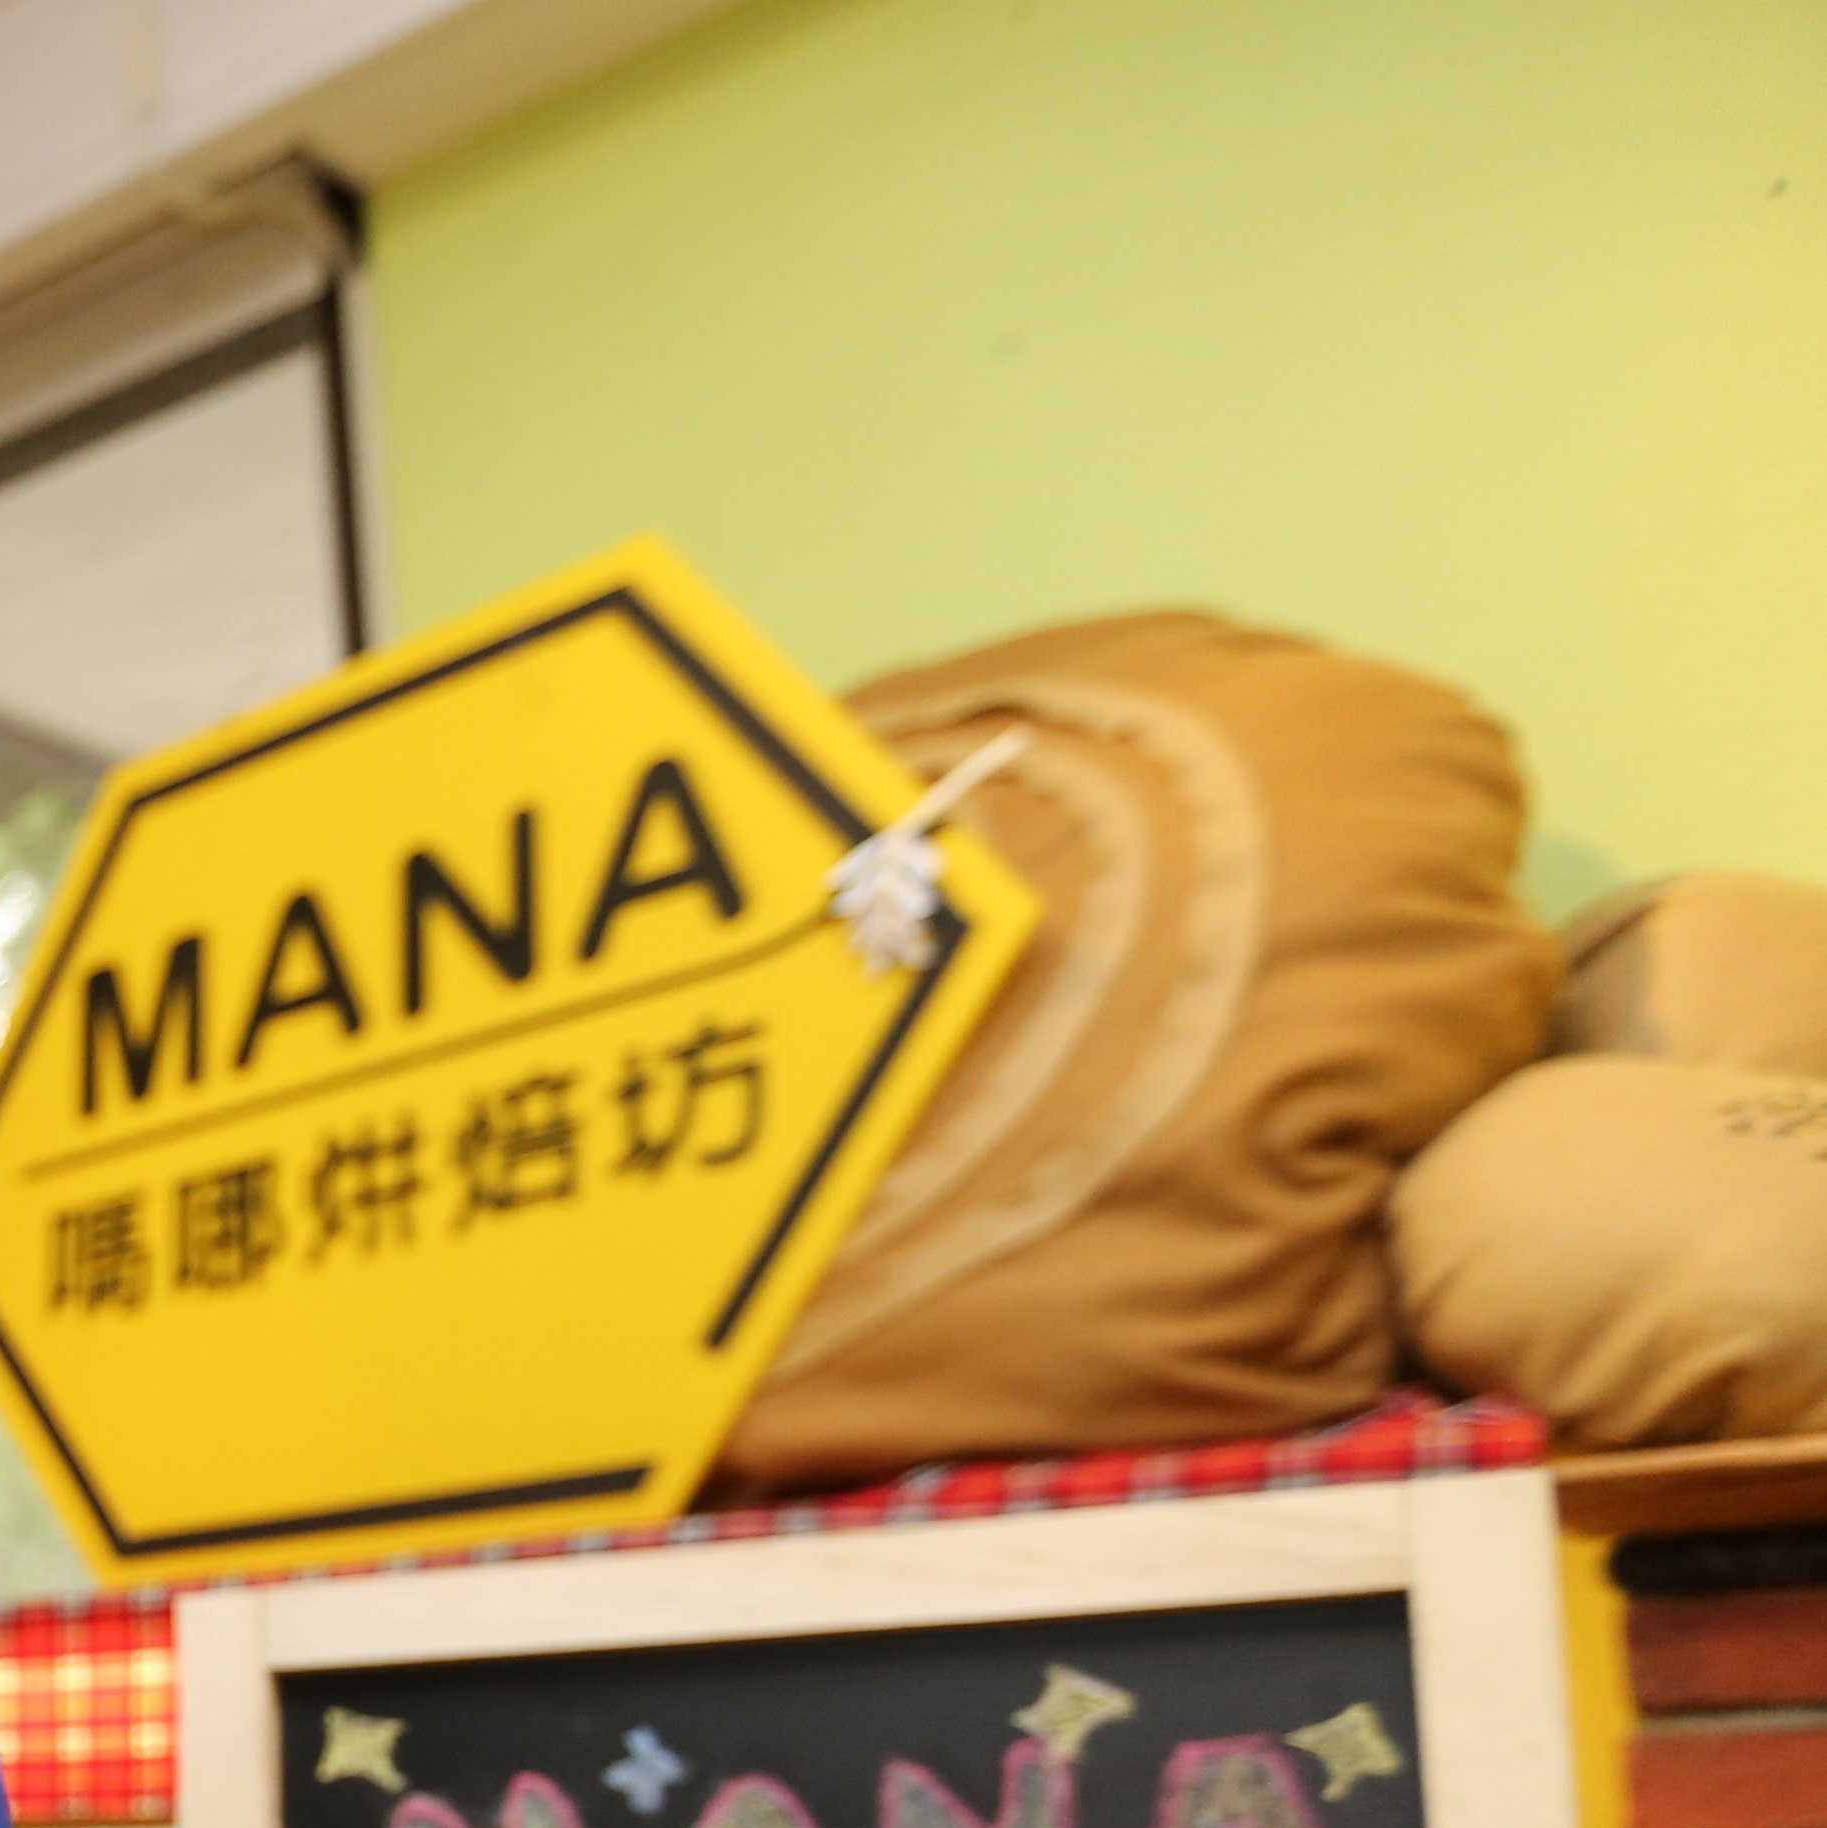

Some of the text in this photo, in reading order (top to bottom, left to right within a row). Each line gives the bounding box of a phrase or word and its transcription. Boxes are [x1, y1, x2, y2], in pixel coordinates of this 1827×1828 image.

[75, 754, 751, 1120] MANA
[45, 1015, 767, 1318] 嗎哪烘焙坊
